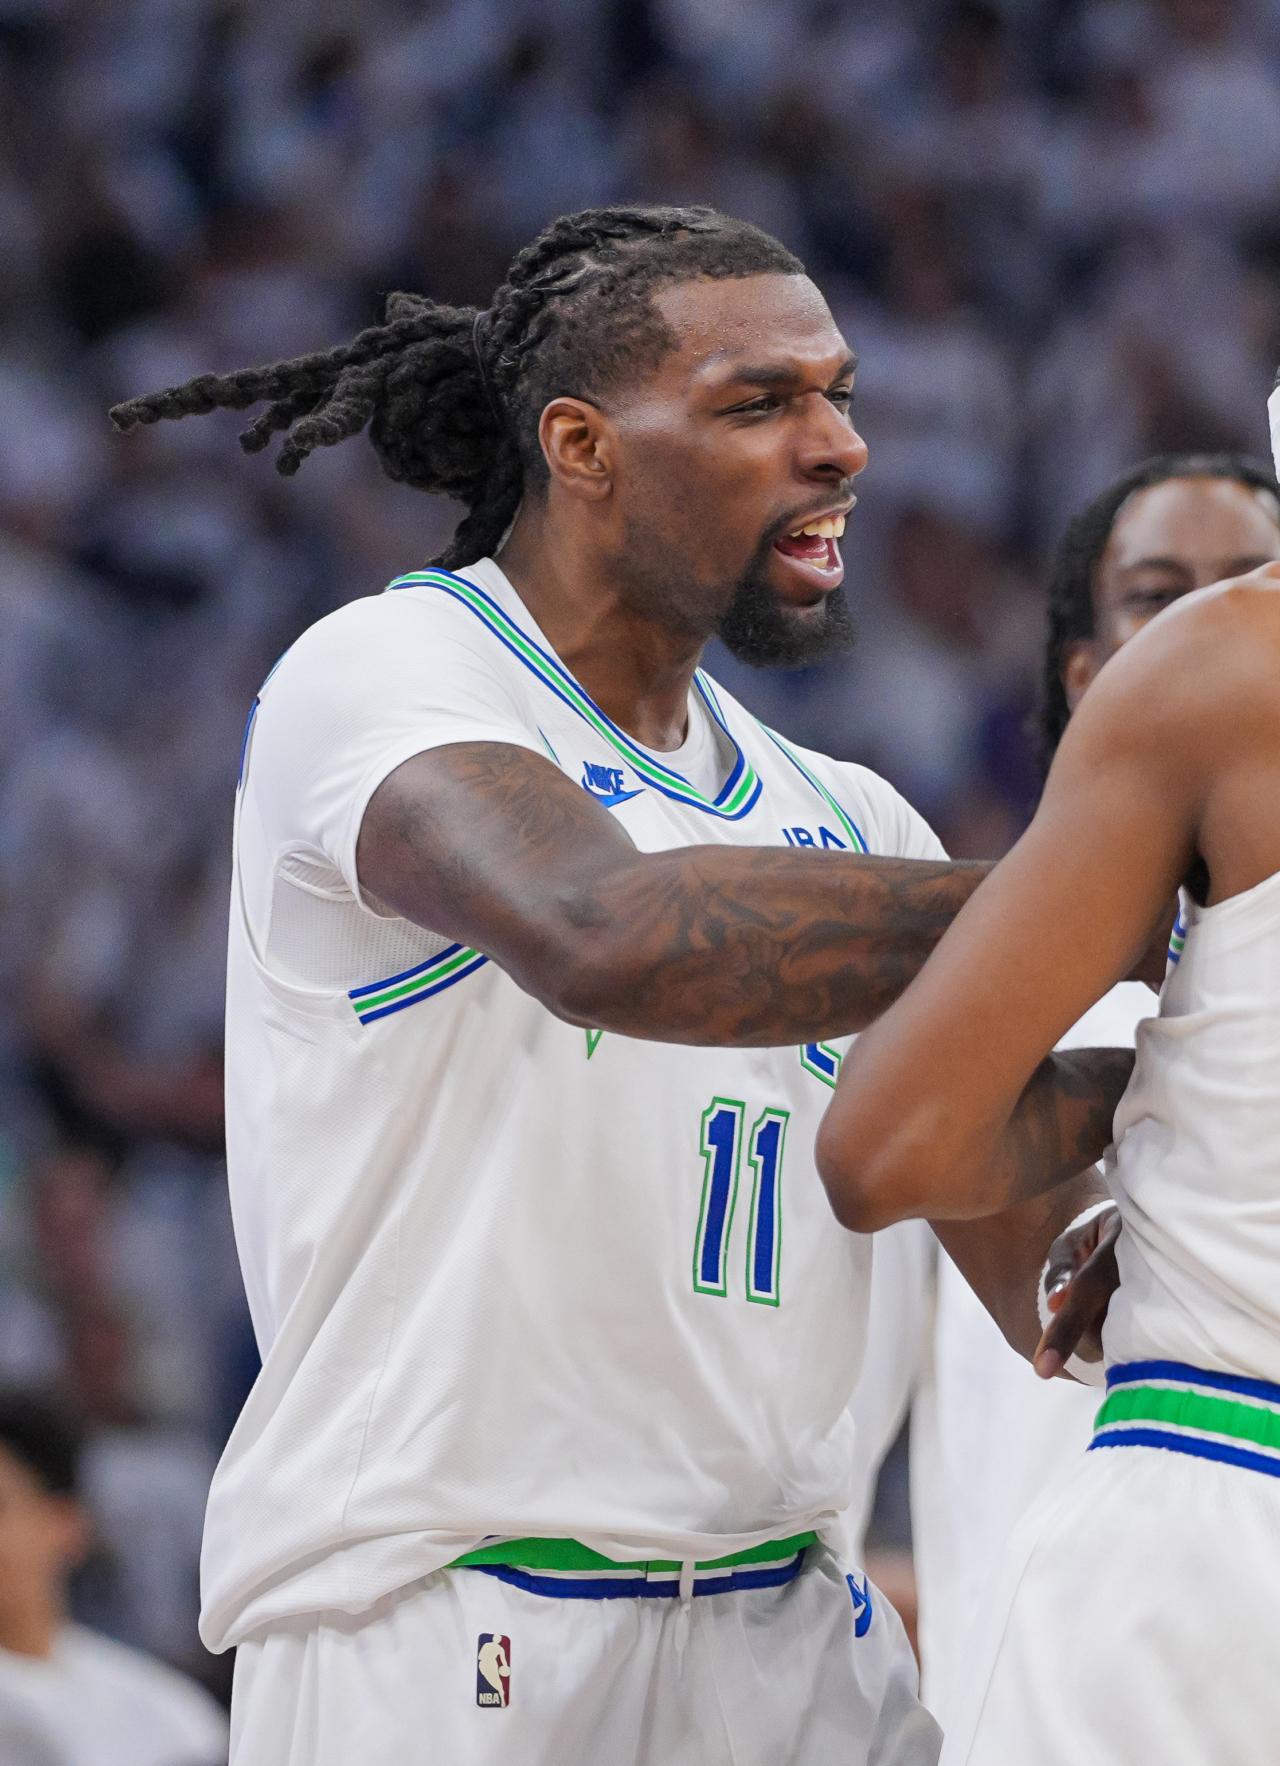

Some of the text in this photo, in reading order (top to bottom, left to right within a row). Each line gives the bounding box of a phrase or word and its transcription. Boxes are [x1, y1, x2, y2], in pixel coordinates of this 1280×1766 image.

[583, 761, 624, 795] NIKE
[693, 1096, 790, 1307] 11
[479, 1692, 501, 1705] NBA
